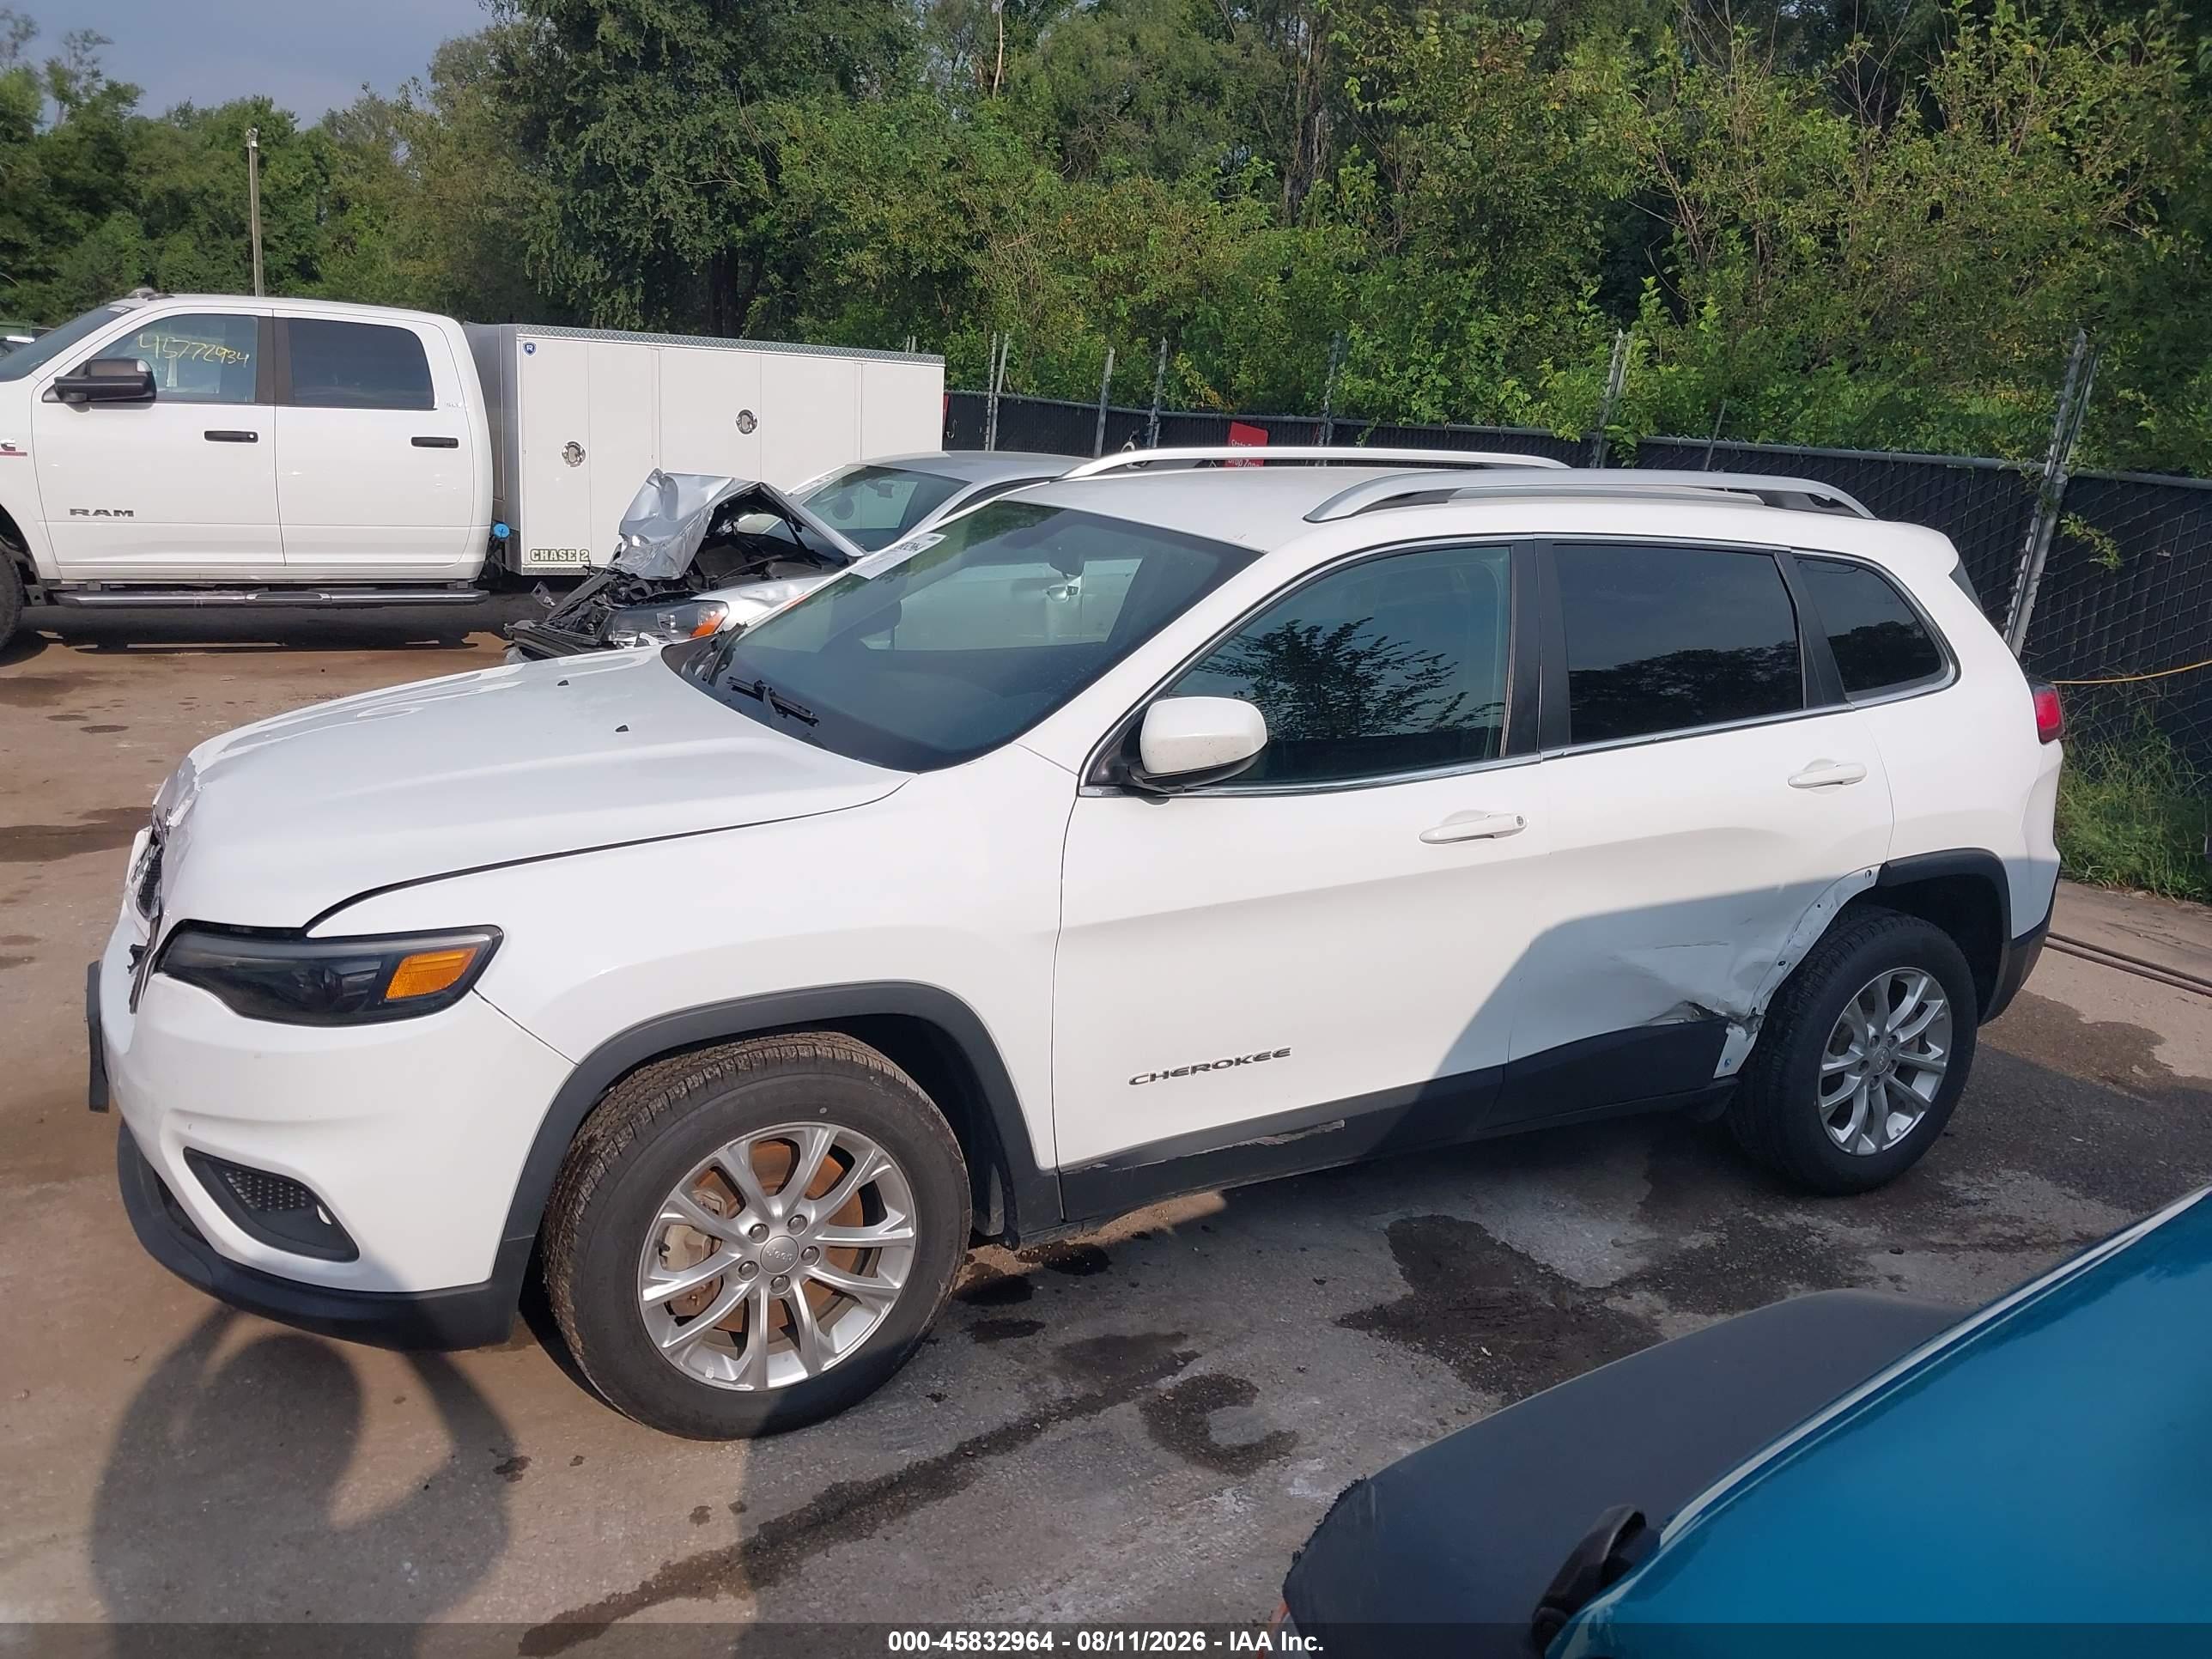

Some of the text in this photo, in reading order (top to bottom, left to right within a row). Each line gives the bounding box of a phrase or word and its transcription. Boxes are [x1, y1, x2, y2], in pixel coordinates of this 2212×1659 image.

[138, 333, 249, 368] 45772934
[70, 508, 134, 517] RAM
[530, 549, 590, 562] CHASE 2
[1128, 1048, 1291, 1085] CHEROKEE
